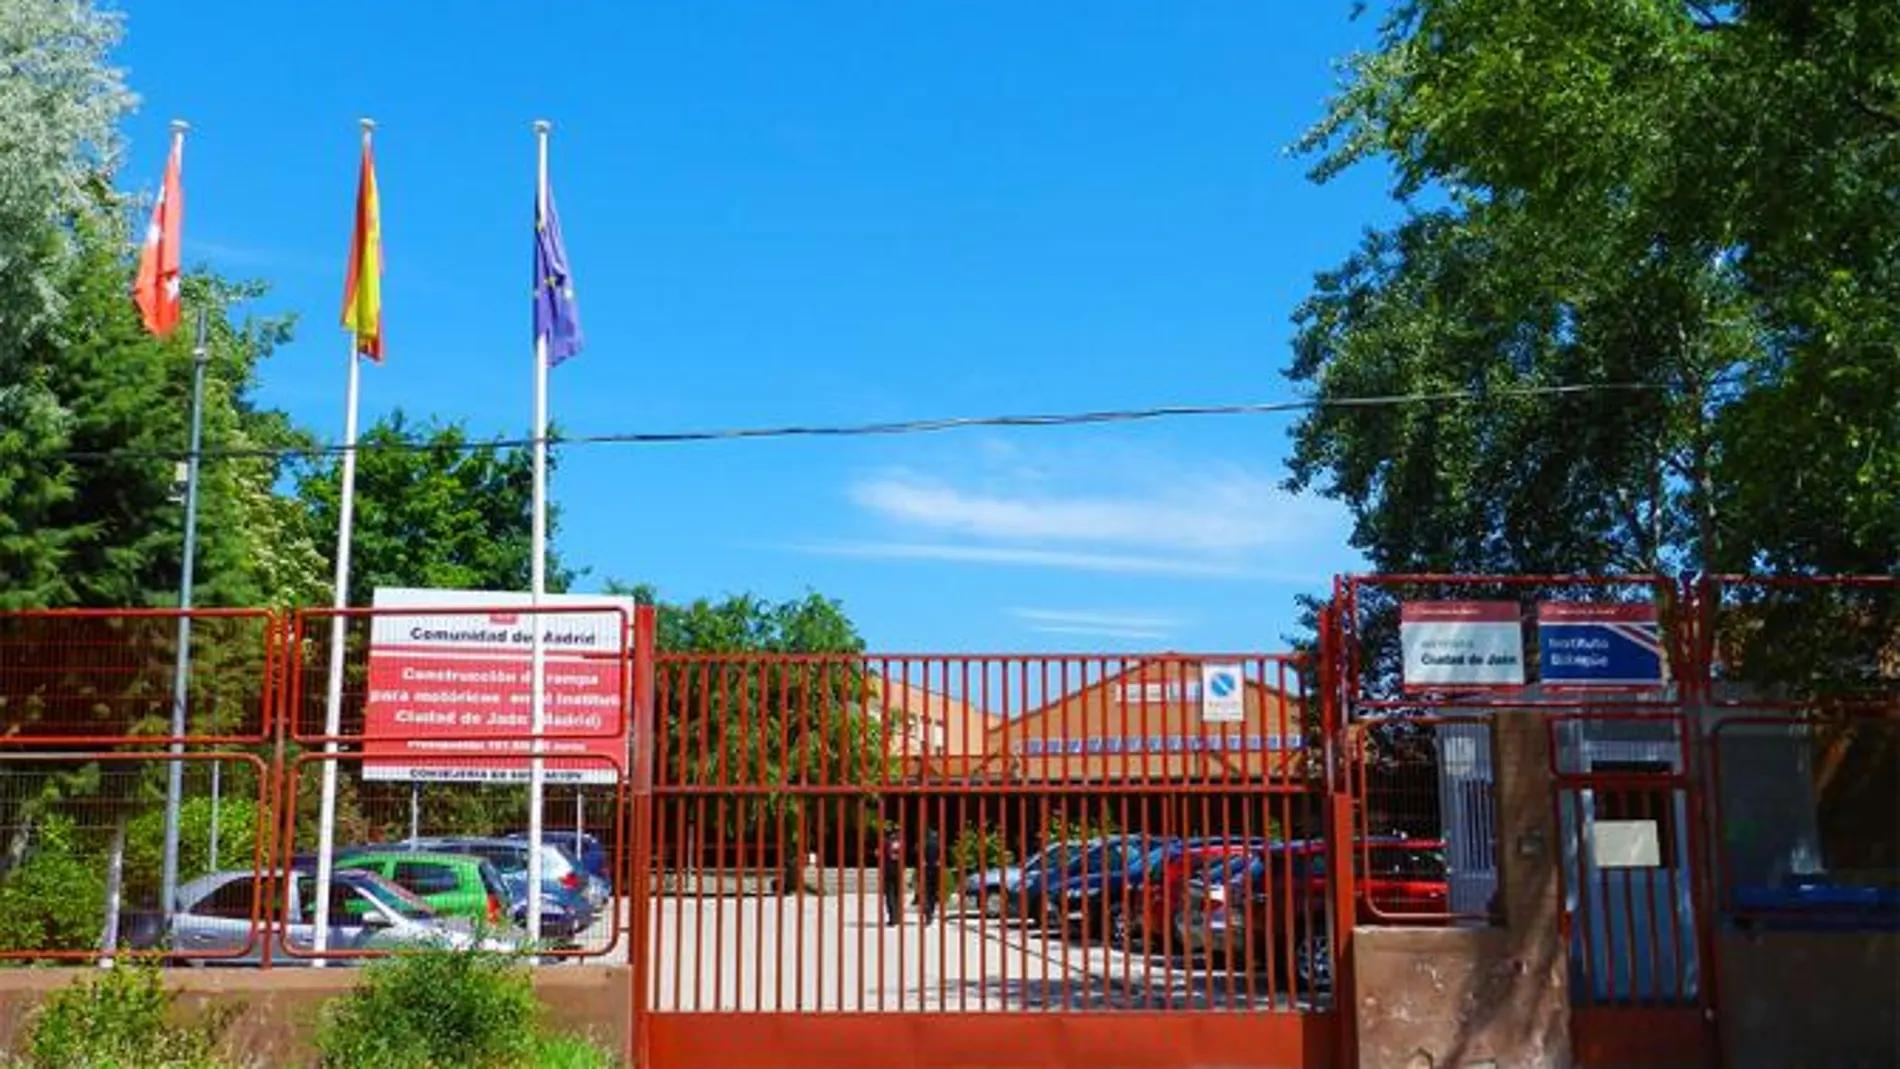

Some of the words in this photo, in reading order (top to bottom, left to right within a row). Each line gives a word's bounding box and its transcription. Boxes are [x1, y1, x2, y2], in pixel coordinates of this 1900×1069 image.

[409, 626, 508, 645] Comunidad
[370, 690, 410, 703] para
[395, 709, 457, 725] Ciudad
[460, 711, 481, 725] de
